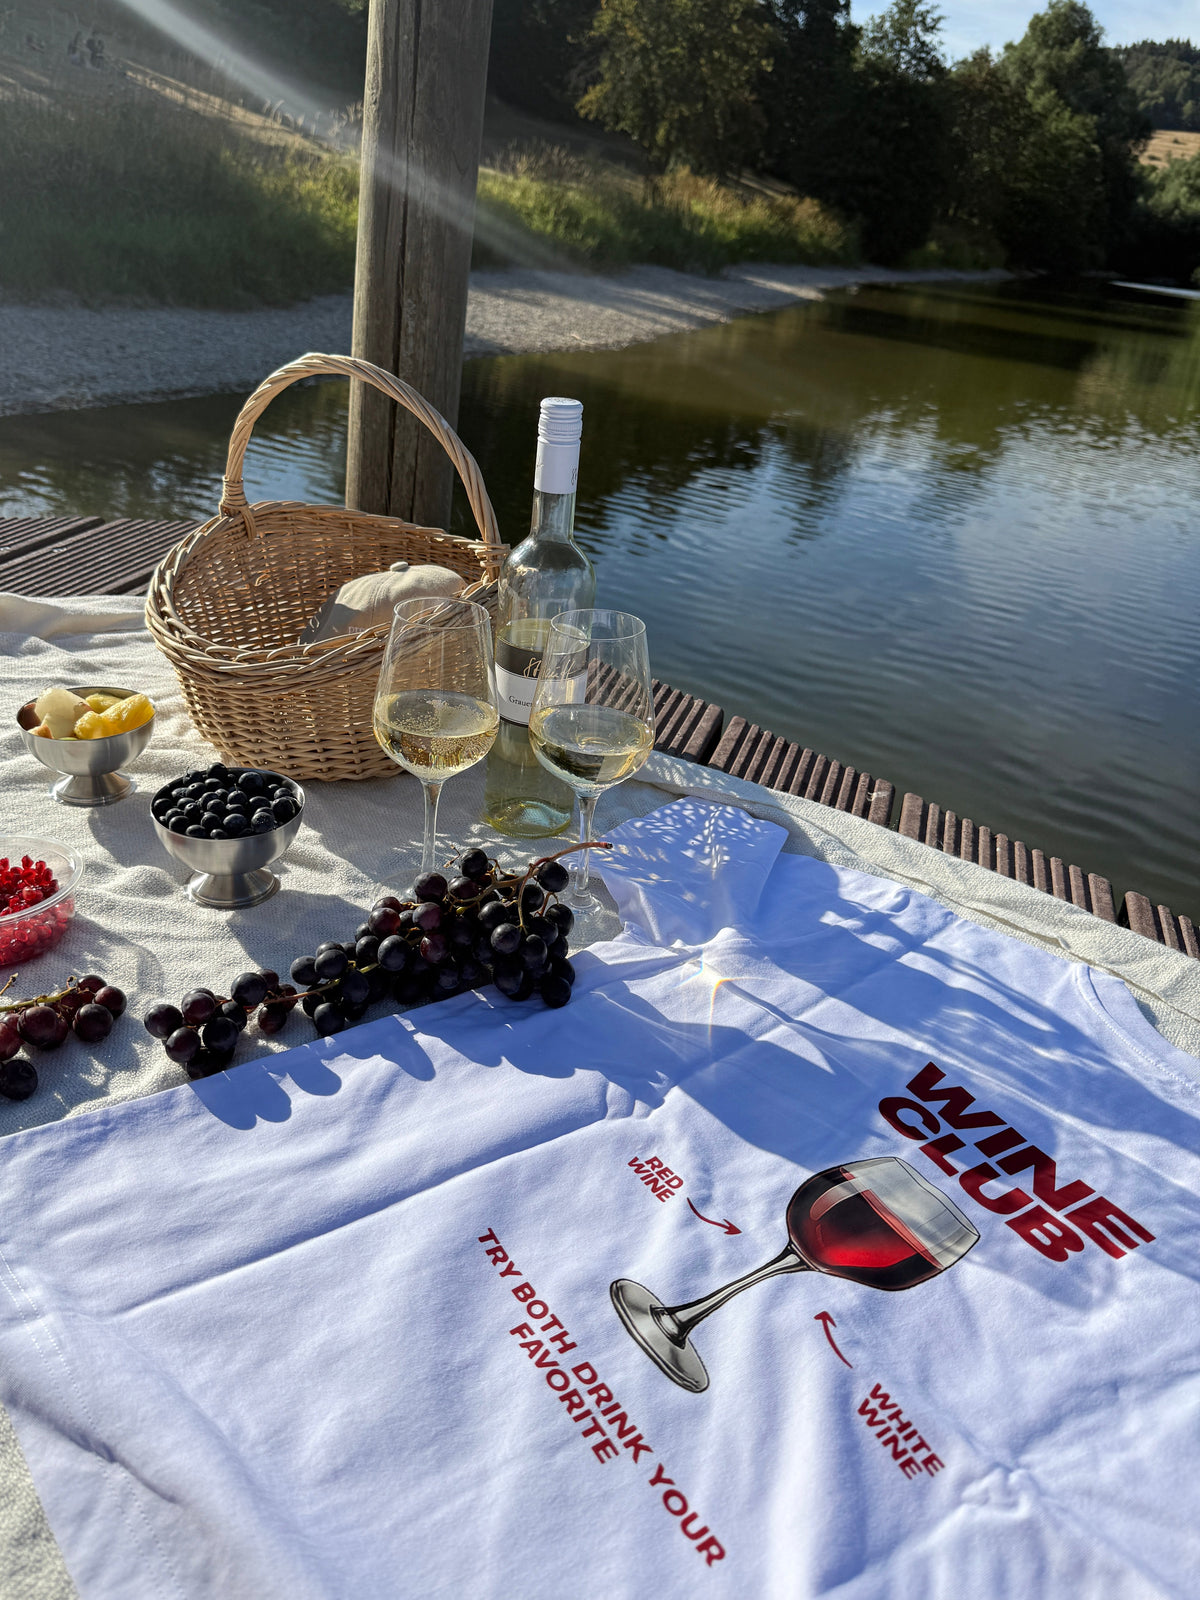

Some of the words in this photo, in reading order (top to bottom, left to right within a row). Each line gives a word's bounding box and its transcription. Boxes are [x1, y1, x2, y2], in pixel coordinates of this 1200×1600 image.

[628, 1157, 675, 1203] WINE
[645, 1156, 684, 1190] RED
[879, 1098, 1085, 1262] CLUB
[906, 1062, 1155, 1259] WINE
[479, 1228, 522, 1278] TRY
[512, 1282, 577, 1354] BOTH
[572, 1362, 652, 1463] DRINK
[649, 1465, 726, 1567] YOUR
[510, 1323, 619, 1464] FAVORITE
[858, 1399, 923, 1480] WINE
[870, 1384, 945, 1477] WHITE
